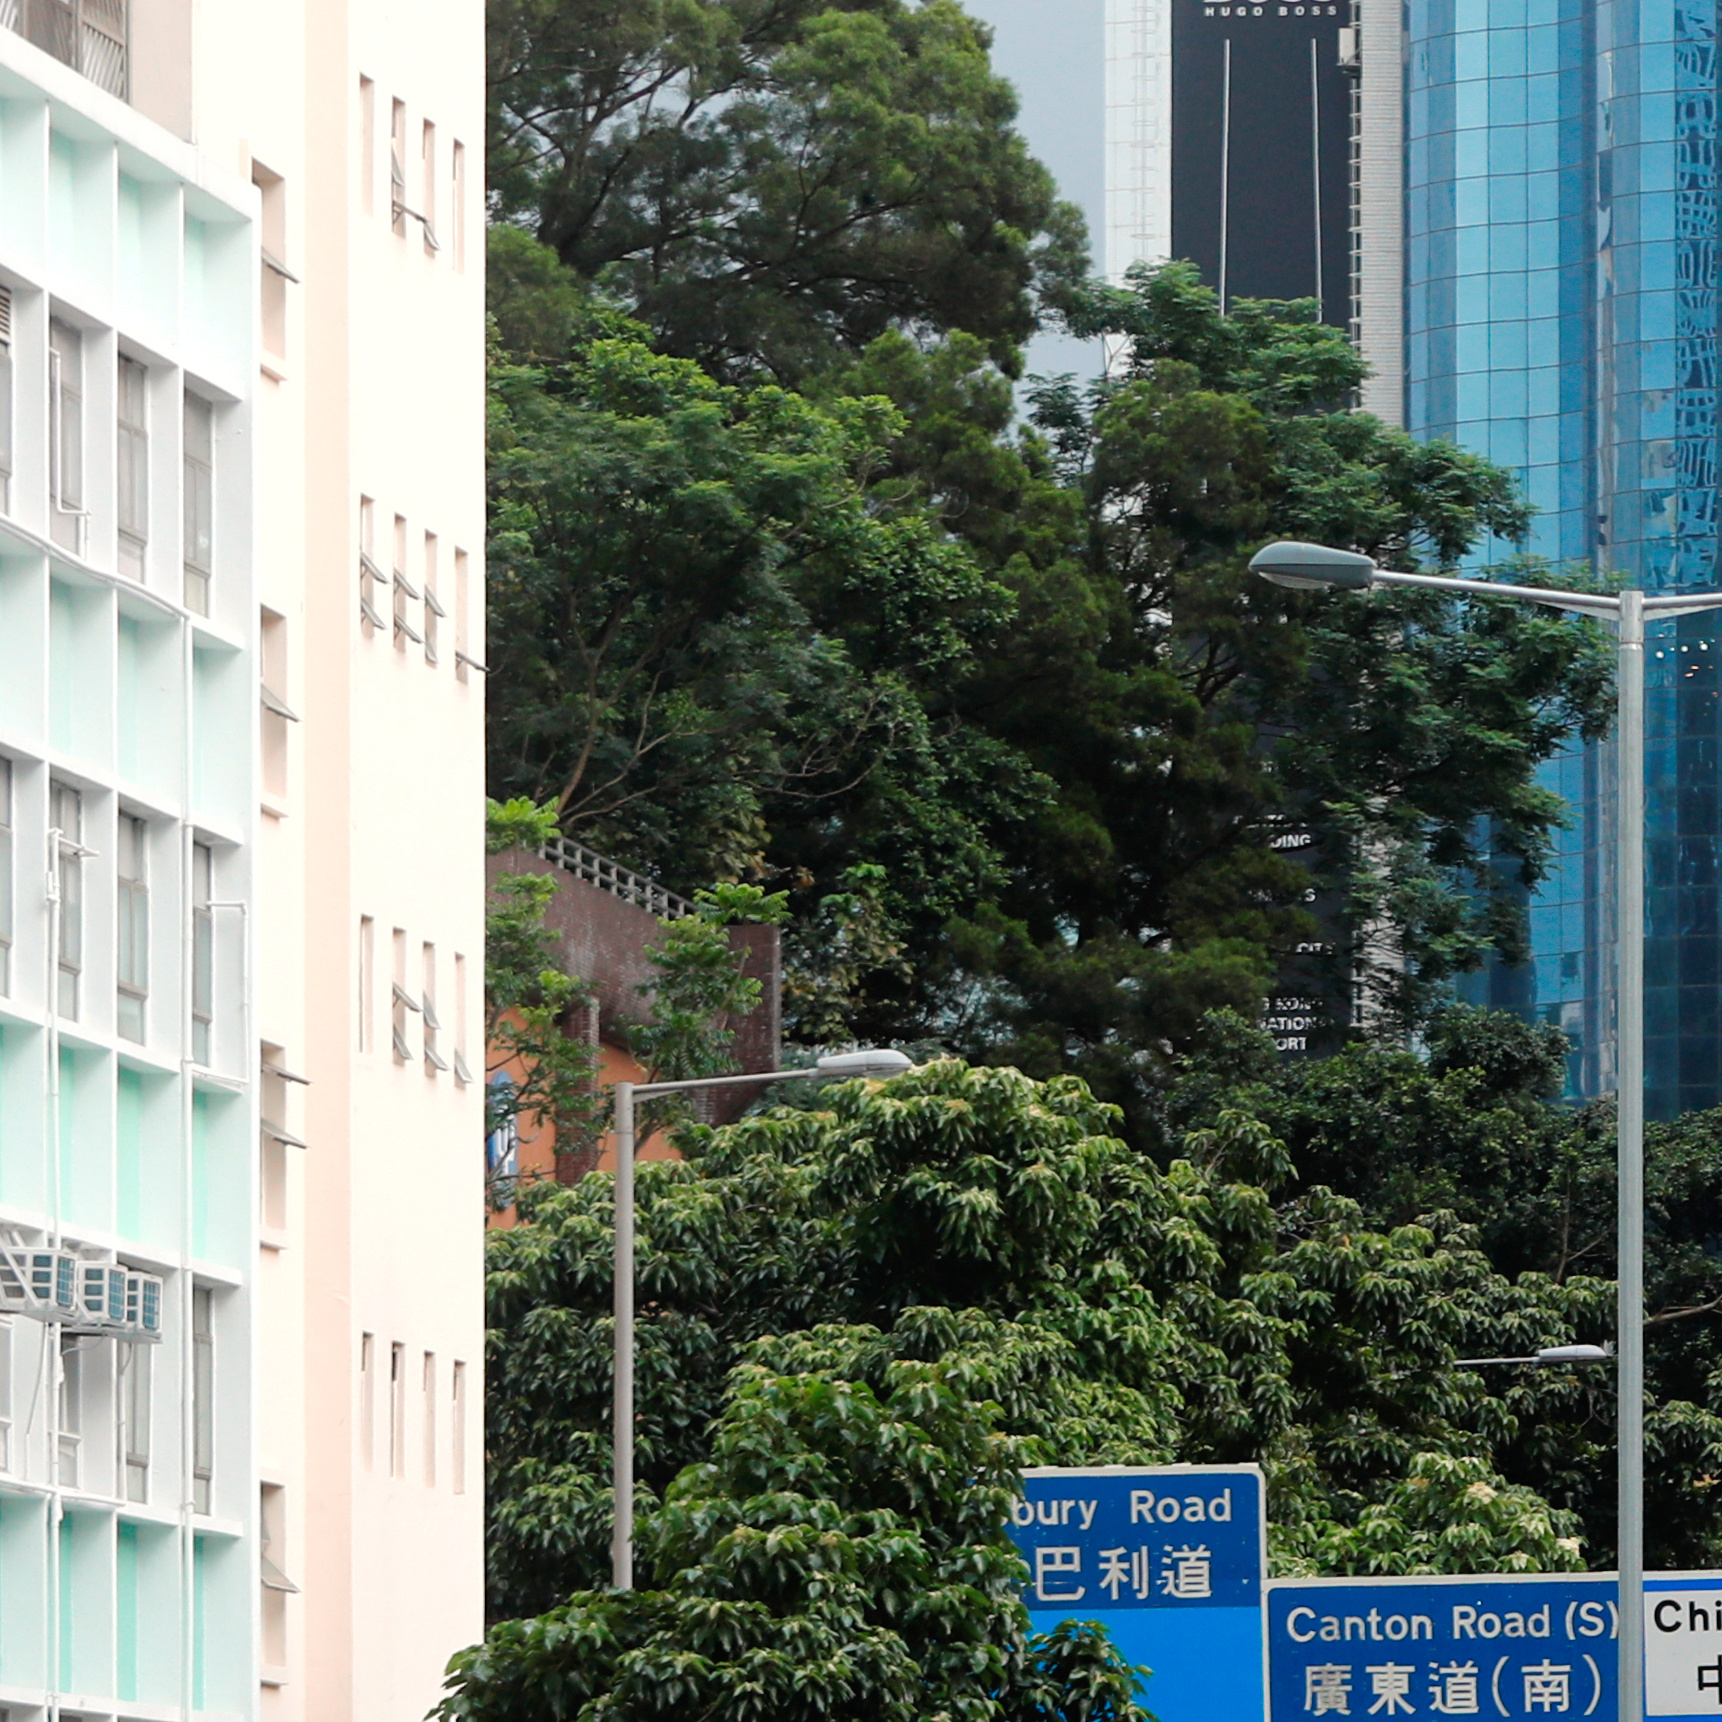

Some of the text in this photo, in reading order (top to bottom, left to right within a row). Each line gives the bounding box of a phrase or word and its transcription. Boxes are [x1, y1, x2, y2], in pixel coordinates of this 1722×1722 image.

[1204, 5, 1337, 17] HUGO BOSS
[1129, 1488, 1233, 1524] Road
[1012, 1544, 1213, 1602] 巴利道
[1285, 1606, 1433, 1643] Canton
[1452, 1604, 1551, 1641] Road
